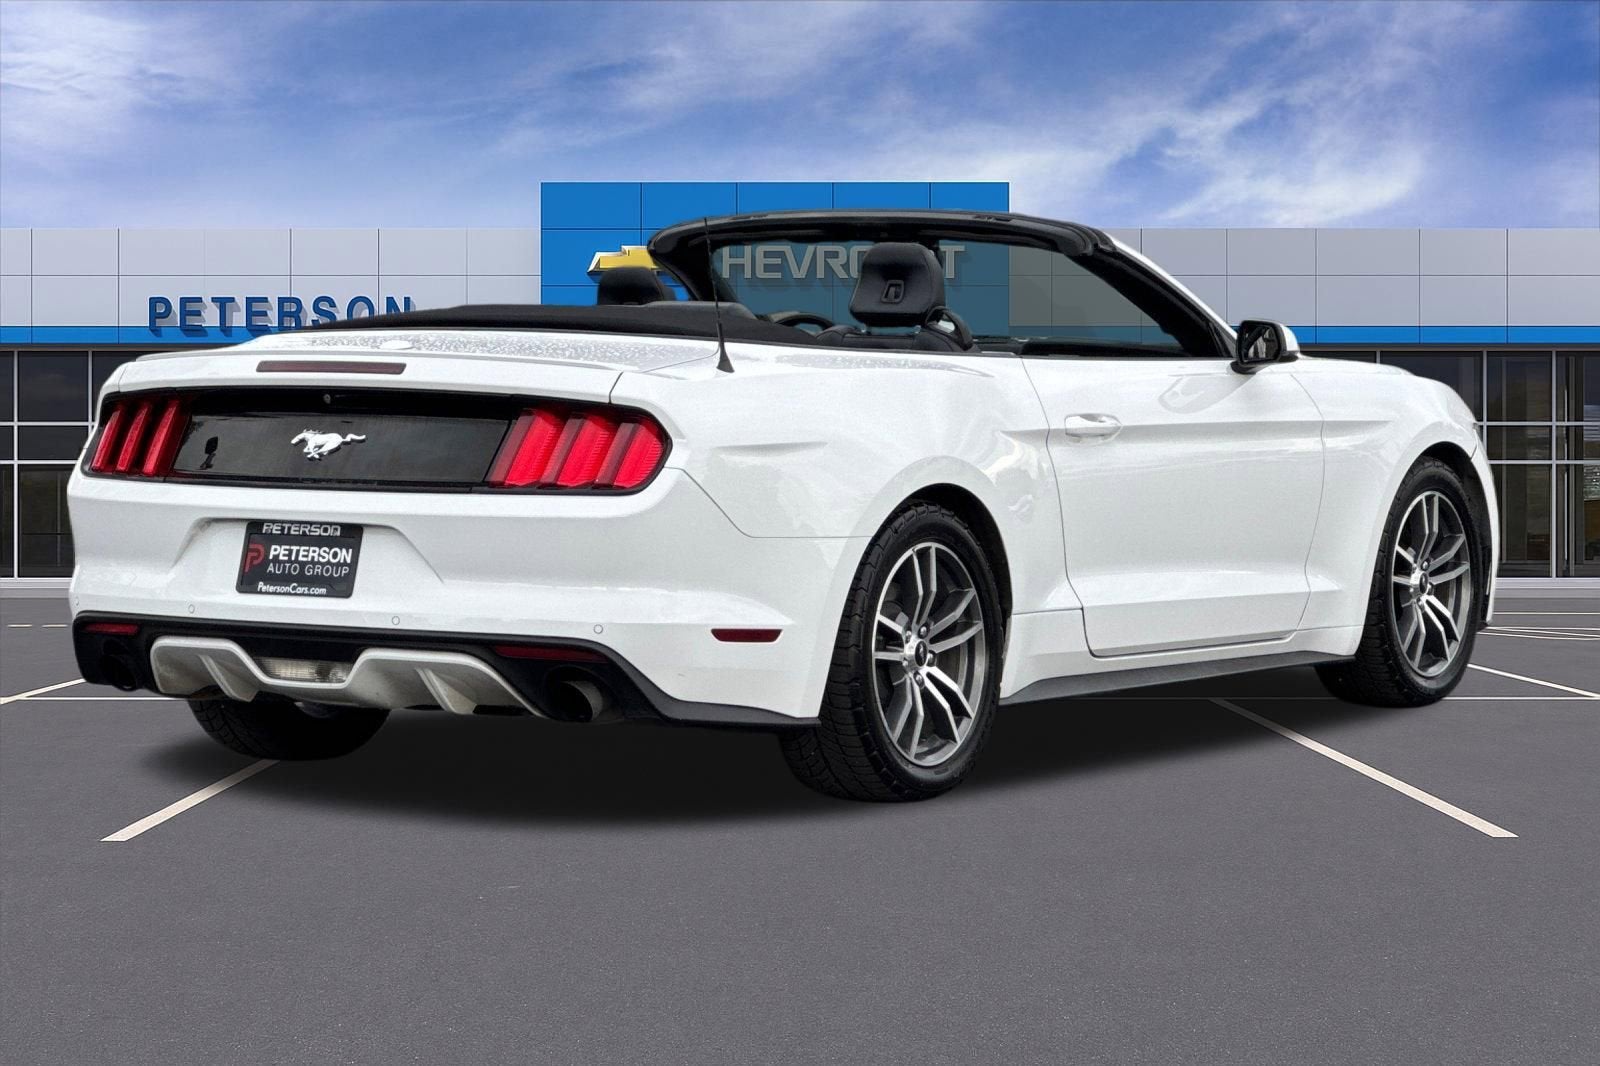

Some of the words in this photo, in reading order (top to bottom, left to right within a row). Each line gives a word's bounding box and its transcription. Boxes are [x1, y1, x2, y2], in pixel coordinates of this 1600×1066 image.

[722, 245, 965, 279] HEVRT
[262, 522, 341, 537] PETERSON
[269, 545, 353, 564] PETERSON
[266, 562, 300, 575] AUTO
[304, 564, 350, 577] GROUP
[257, 581, 327, 595] PetersonCars.com
